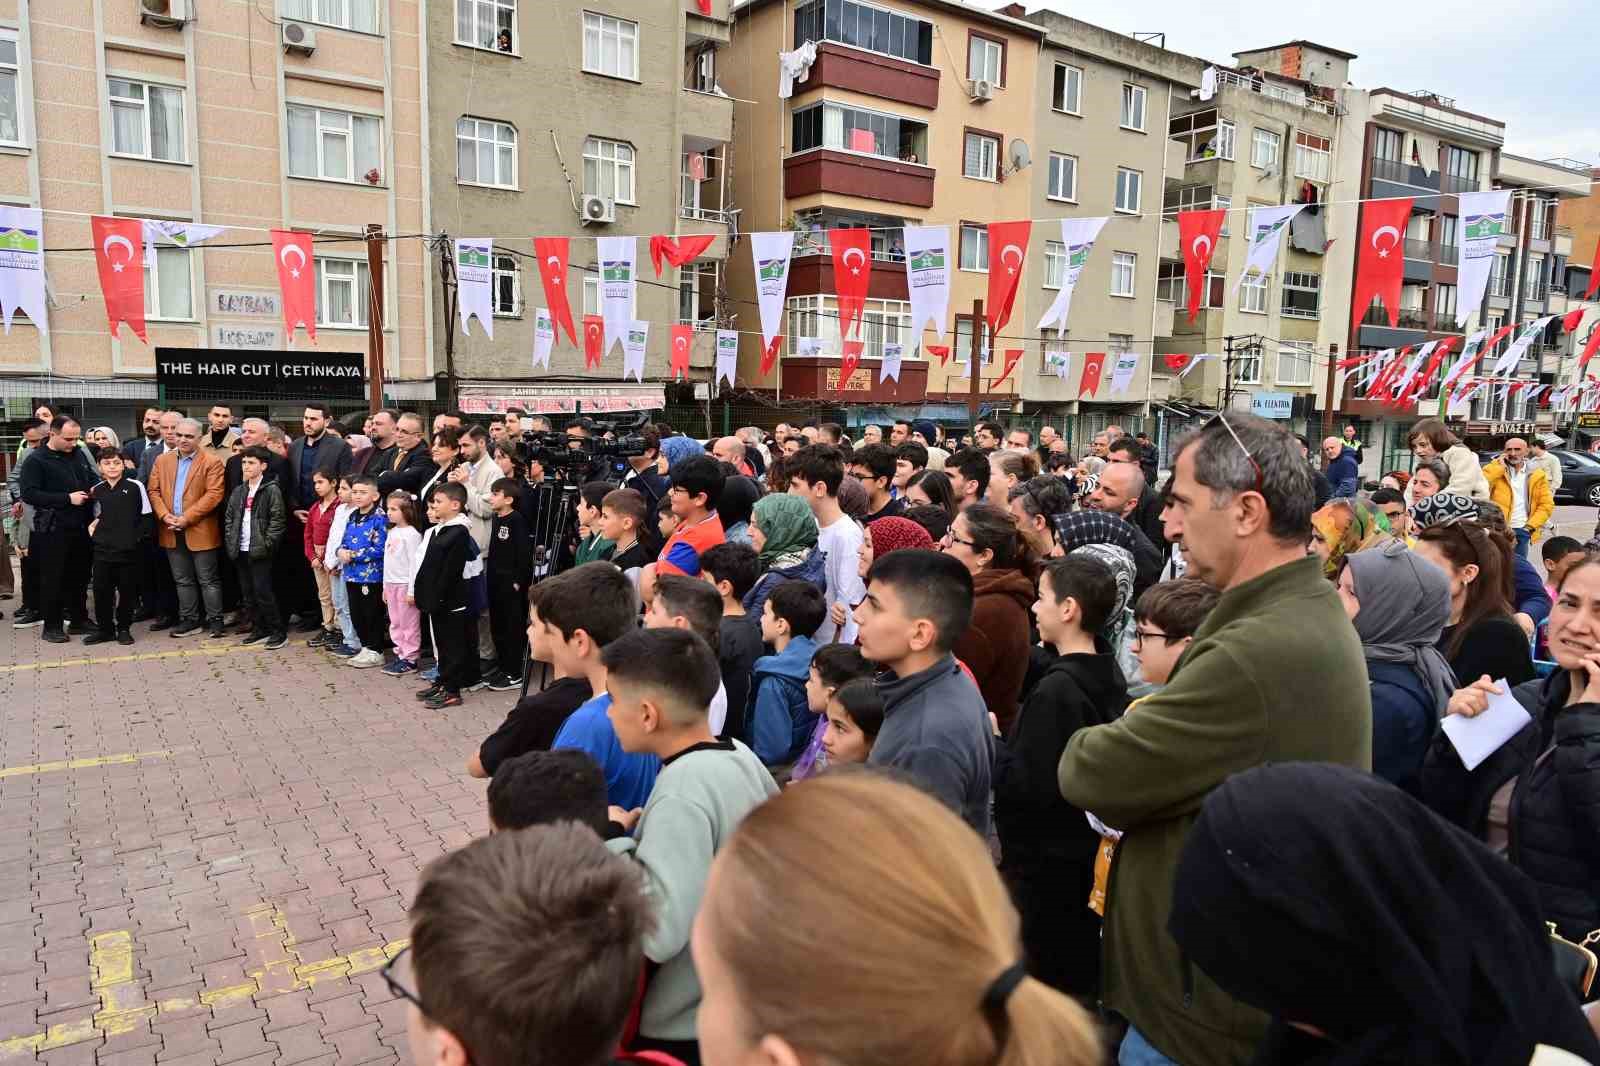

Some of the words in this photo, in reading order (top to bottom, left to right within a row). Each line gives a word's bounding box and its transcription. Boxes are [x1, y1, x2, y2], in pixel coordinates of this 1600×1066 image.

[160, 362, 193, 375] THE
[198, 363, 236, 375] HAIR
[241, 364, 271, 376] CUT
[282, 362, 361, 378] ÇETİNKAYA
[1498, 423, 1522, 434] AYAZ
[1524, 423, 1536, 434] ET
